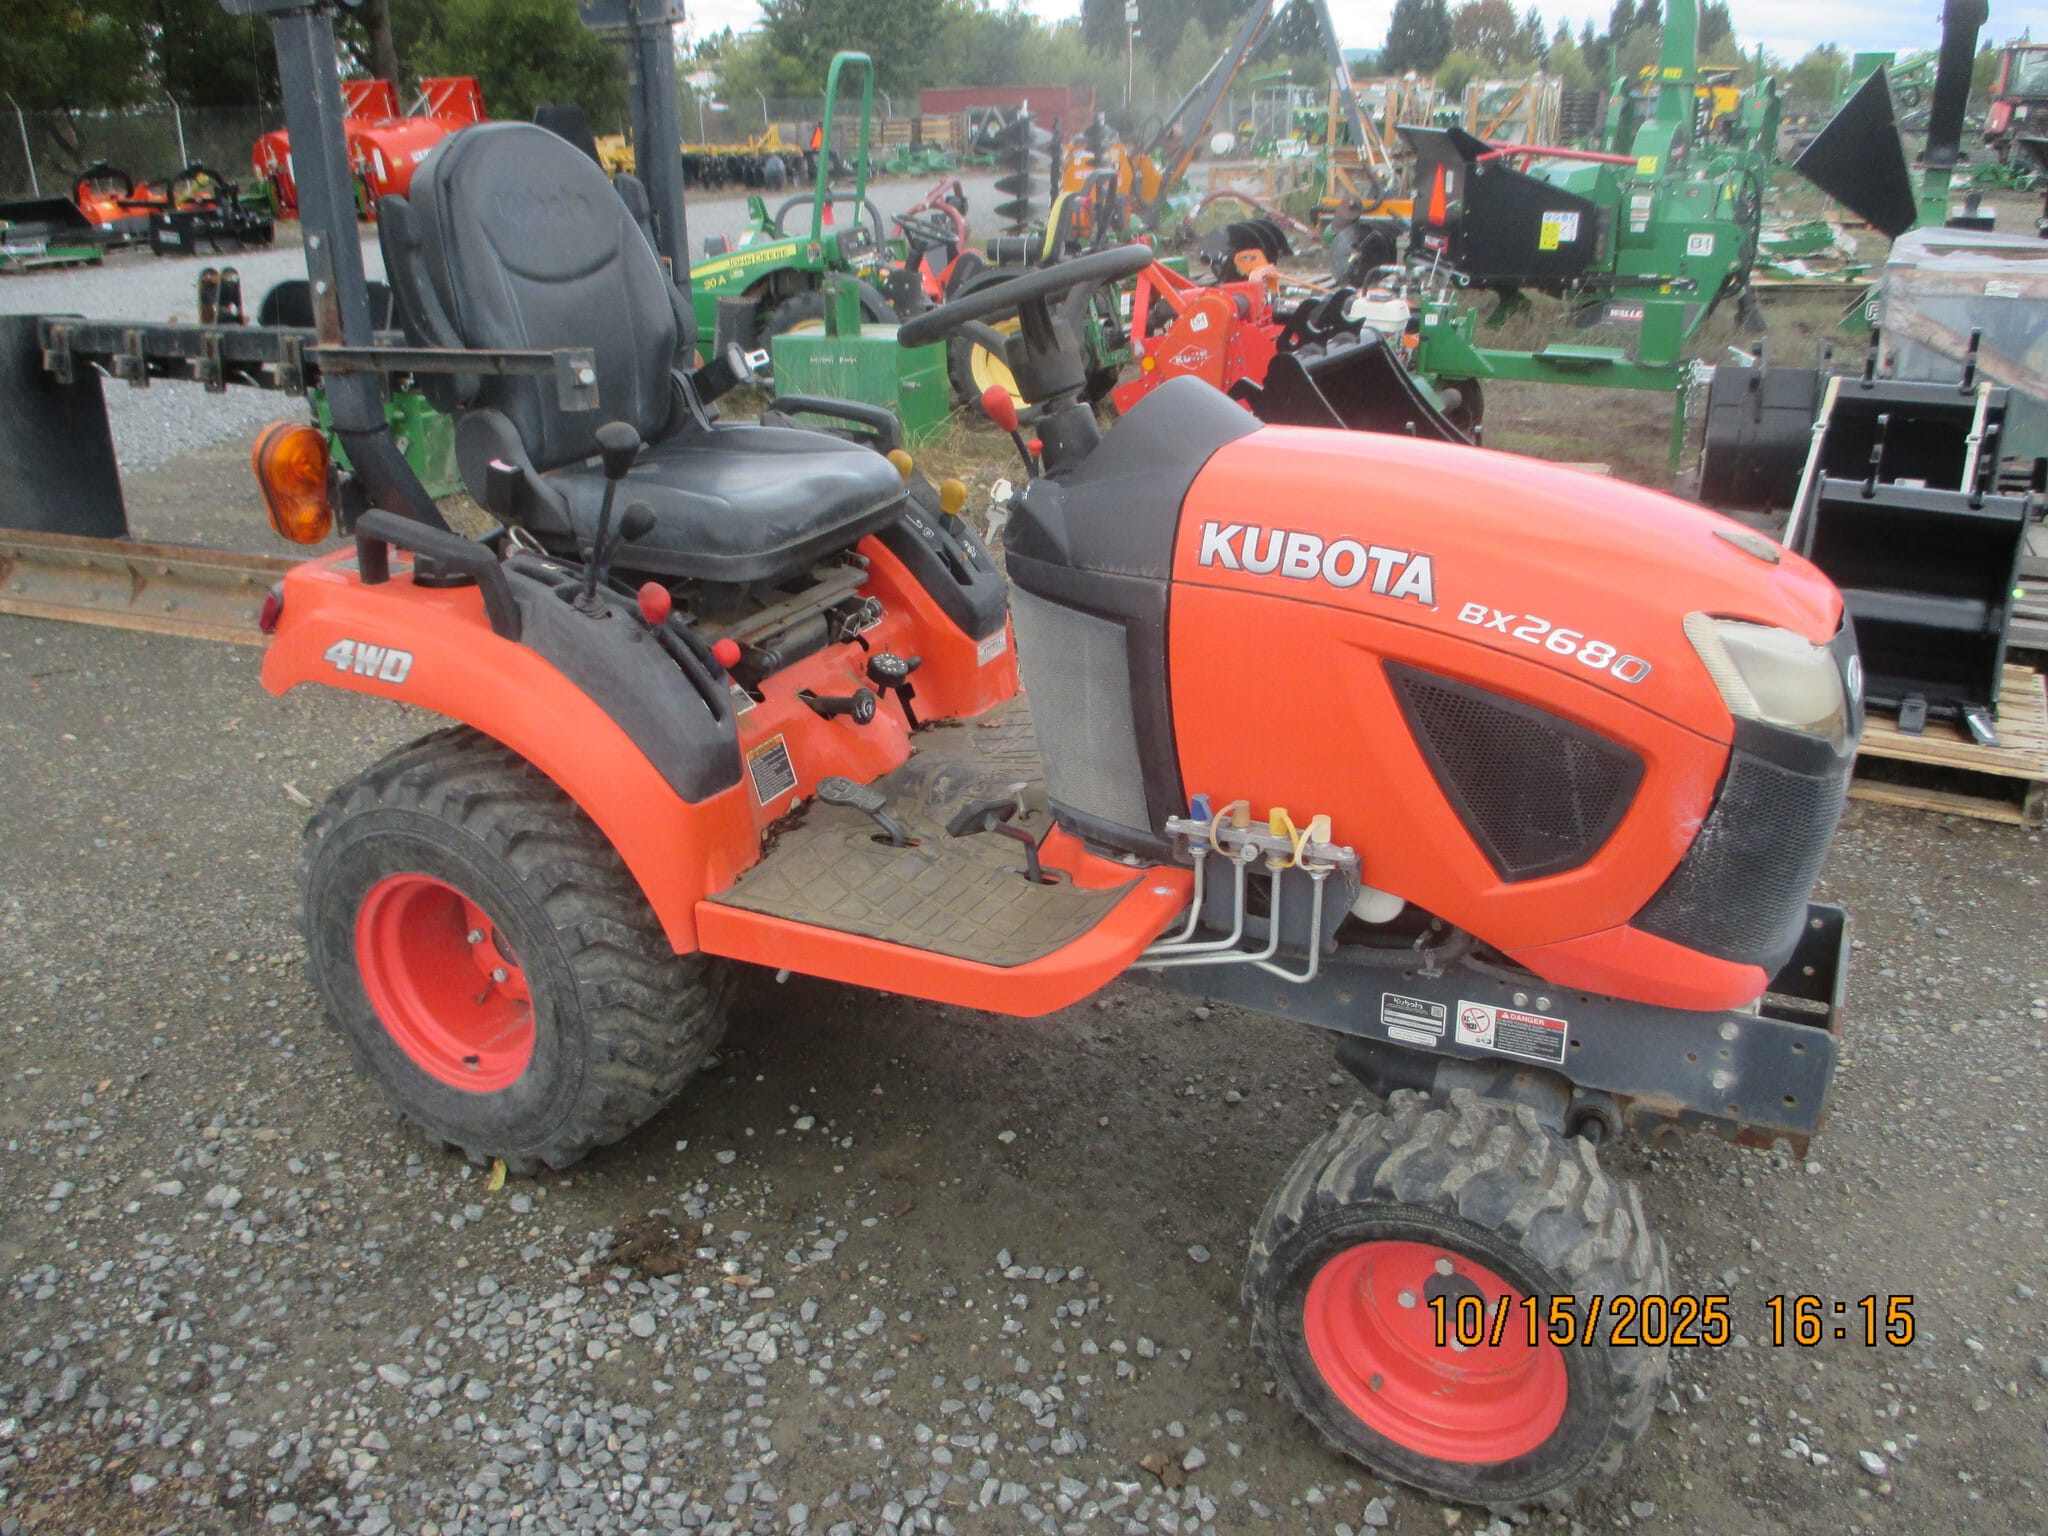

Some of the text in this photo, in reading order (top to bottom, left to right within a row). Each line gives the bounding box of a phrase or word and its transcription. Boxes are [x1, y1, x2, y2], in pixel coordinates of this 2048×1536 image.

[1198, 520, 1438, 606] KUBOTA
[323, 638, 414, 685] 4WD
[1457, 601, 1652, 684] BX2680
[1510, 1012, 1545, 1027] DANGER
